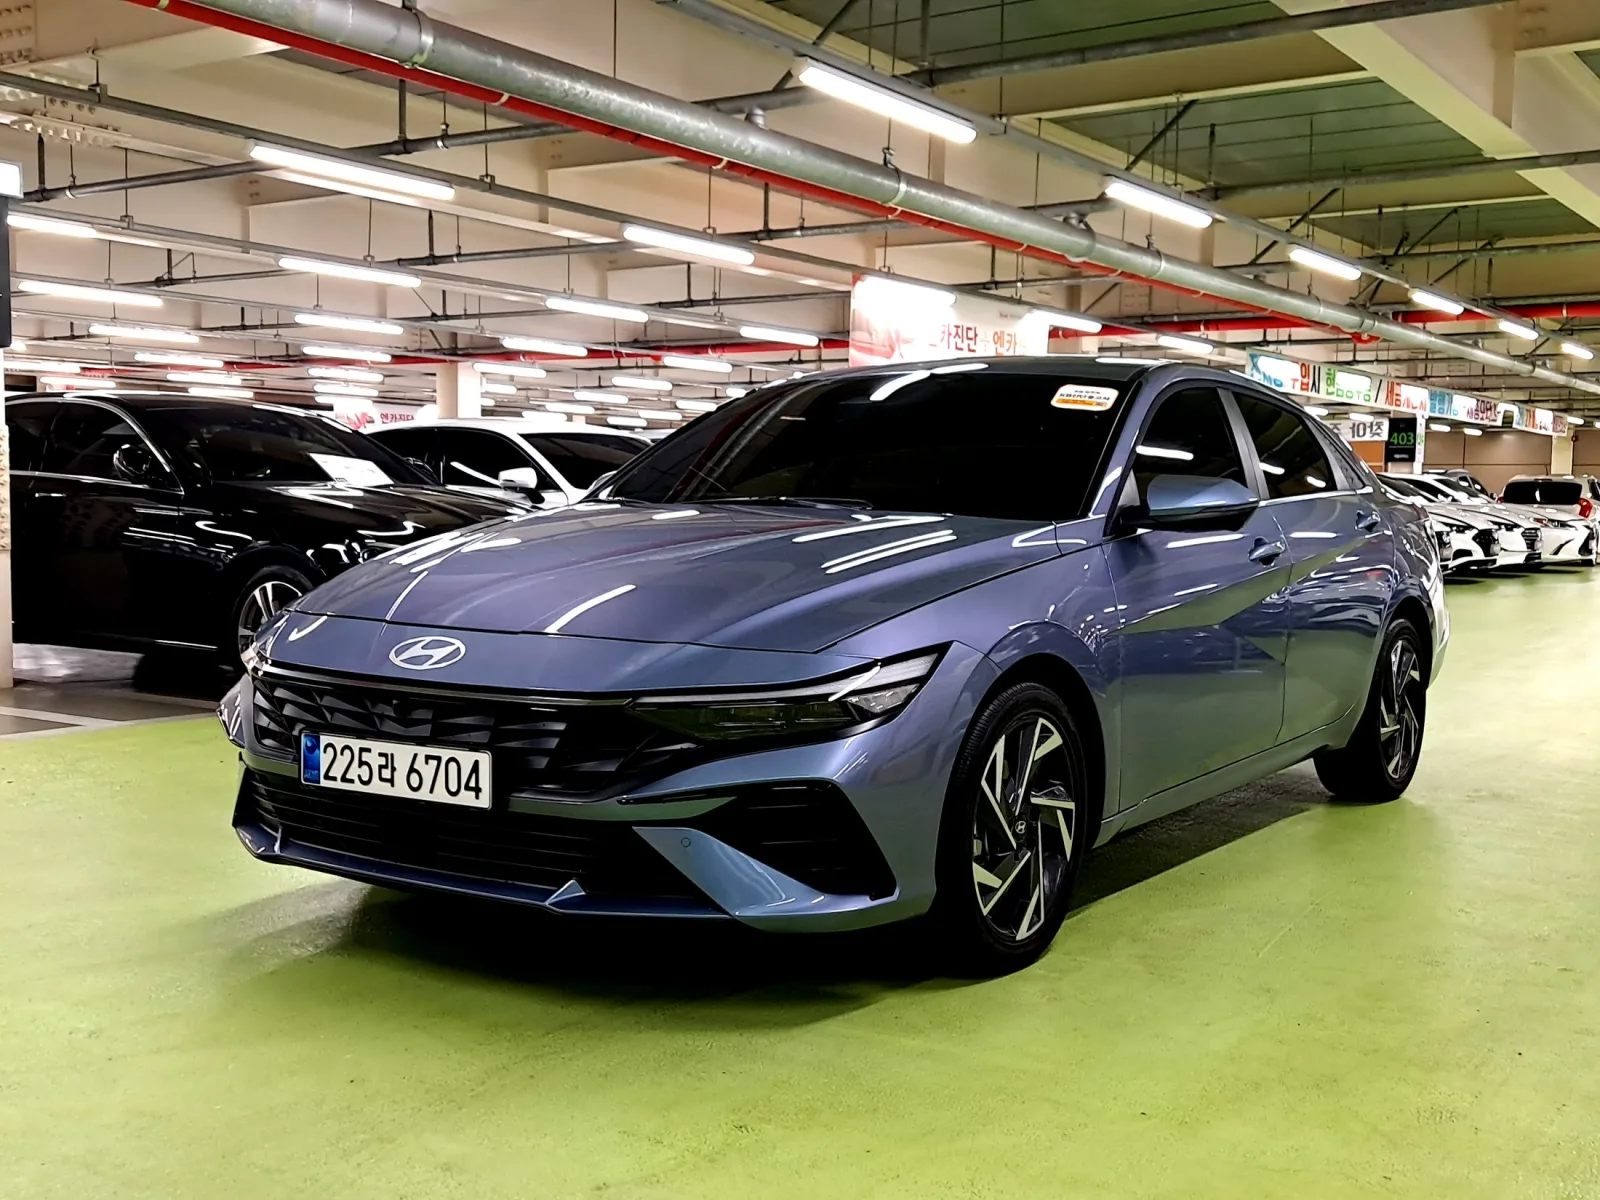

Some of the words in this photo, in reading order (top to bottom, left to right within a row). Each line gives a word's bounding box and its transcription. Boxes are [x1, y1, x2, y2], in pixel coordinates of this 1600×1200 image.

[929, 323, 979, 353] 카진단
[1389, 432, 1415, 445] 403
[323, 742, 397, 788] 225라
[406, 752, 483, 800] 6704
